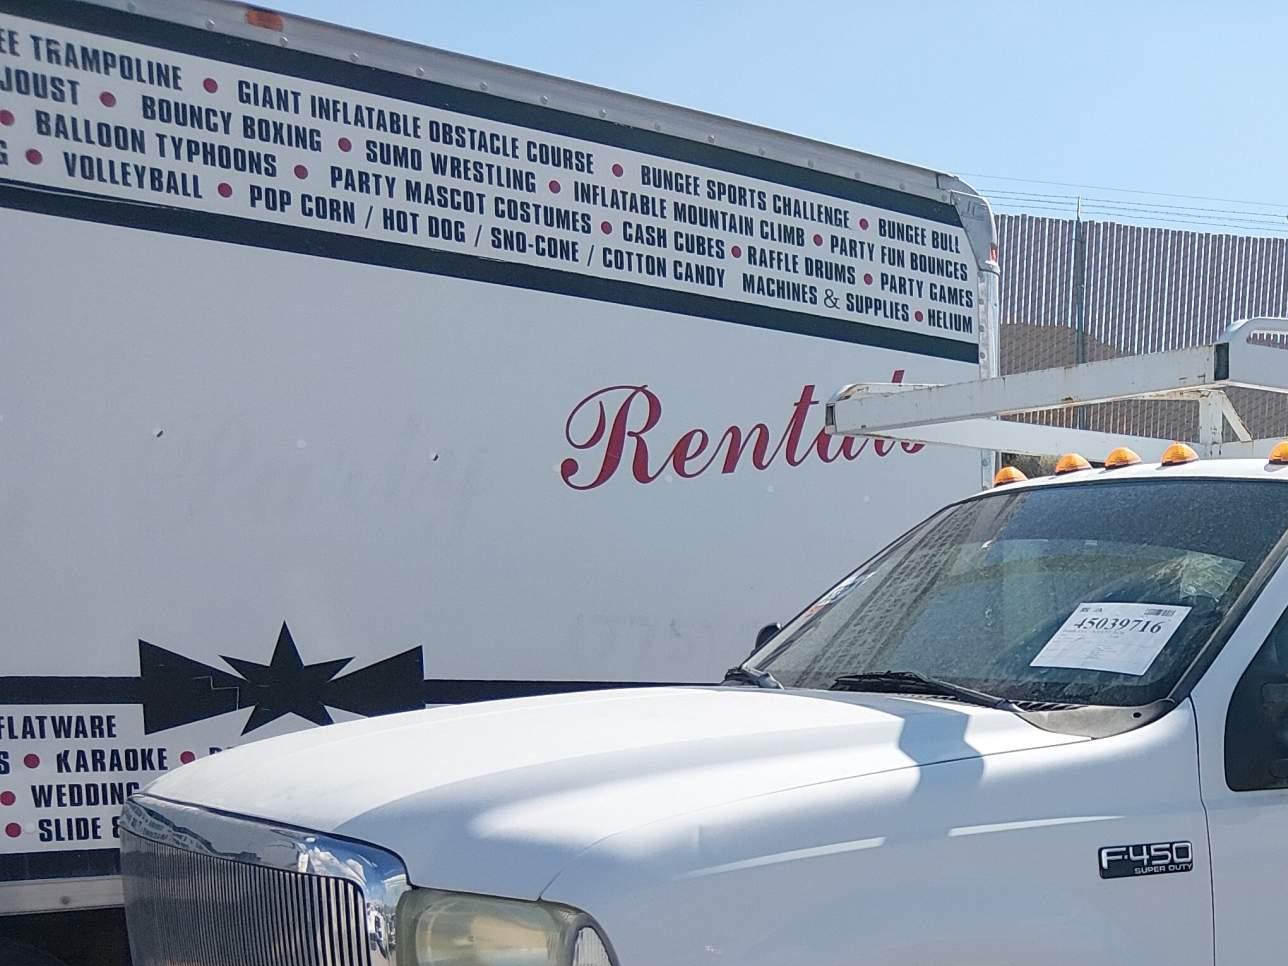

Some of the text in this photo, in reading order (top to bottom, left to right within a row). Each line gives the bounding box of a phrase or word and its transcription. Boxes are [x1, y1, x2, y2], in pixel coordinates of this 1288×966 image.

[0, 66, 968, 282] JOUST BOUNCY BOXING SUMO WRESTLING INFLATABLE MOUNTAIN CLIMB PARTY FUN BOUNCES
[30, 34, 183, 91] TRAMPOLINE
[237, 79, 302, 115] GIANT
[310, 94, 421, 139] INFLATABLE
[428, 119, 520, 160] OBSTACLE
[526, 140, 595, 175] COURSE
[640, 165, 701, 197] BUNGEE
[706, 179, 767, 211] SPORTS
[772, 194, 850, 229] CHALLENGE
[878, 217, 927, 247] BUNGEE
[931, 230, 961, 254] BULL
[35, 109, 974, 309] BALLOON TYPHOONS PARTY MASCOT COSTUMES CASH CUBES RAFFLE DRUMS PARTY GAMES
[63, 151, 203, 199] VOLLEYBALL
[249, 184, 292, 213] POP
[300, 193, 356, 225] CORN
[382, 207, 420, 235] HOT
[427, 215, 466, 244] DOG
[491, 227, 579, 263] SNO-CONE
[602, 247, 667, 278] COTTON
[673, 259, 726, 289] CANDY
[742, 272, 819, 306] MACHINES
[823, 288, 841, 310] &
[846, 292, 910, 322] SUPPLIES
[927, 308, 973, 334] HELIUM
[1073, 617, 1166, 634] 45039716
[56, 747, 169, 774] KARAOKE
[38, 816, 101, 842] SLIDE
[1134, 862, 1193, 875] SUPER DUTY
